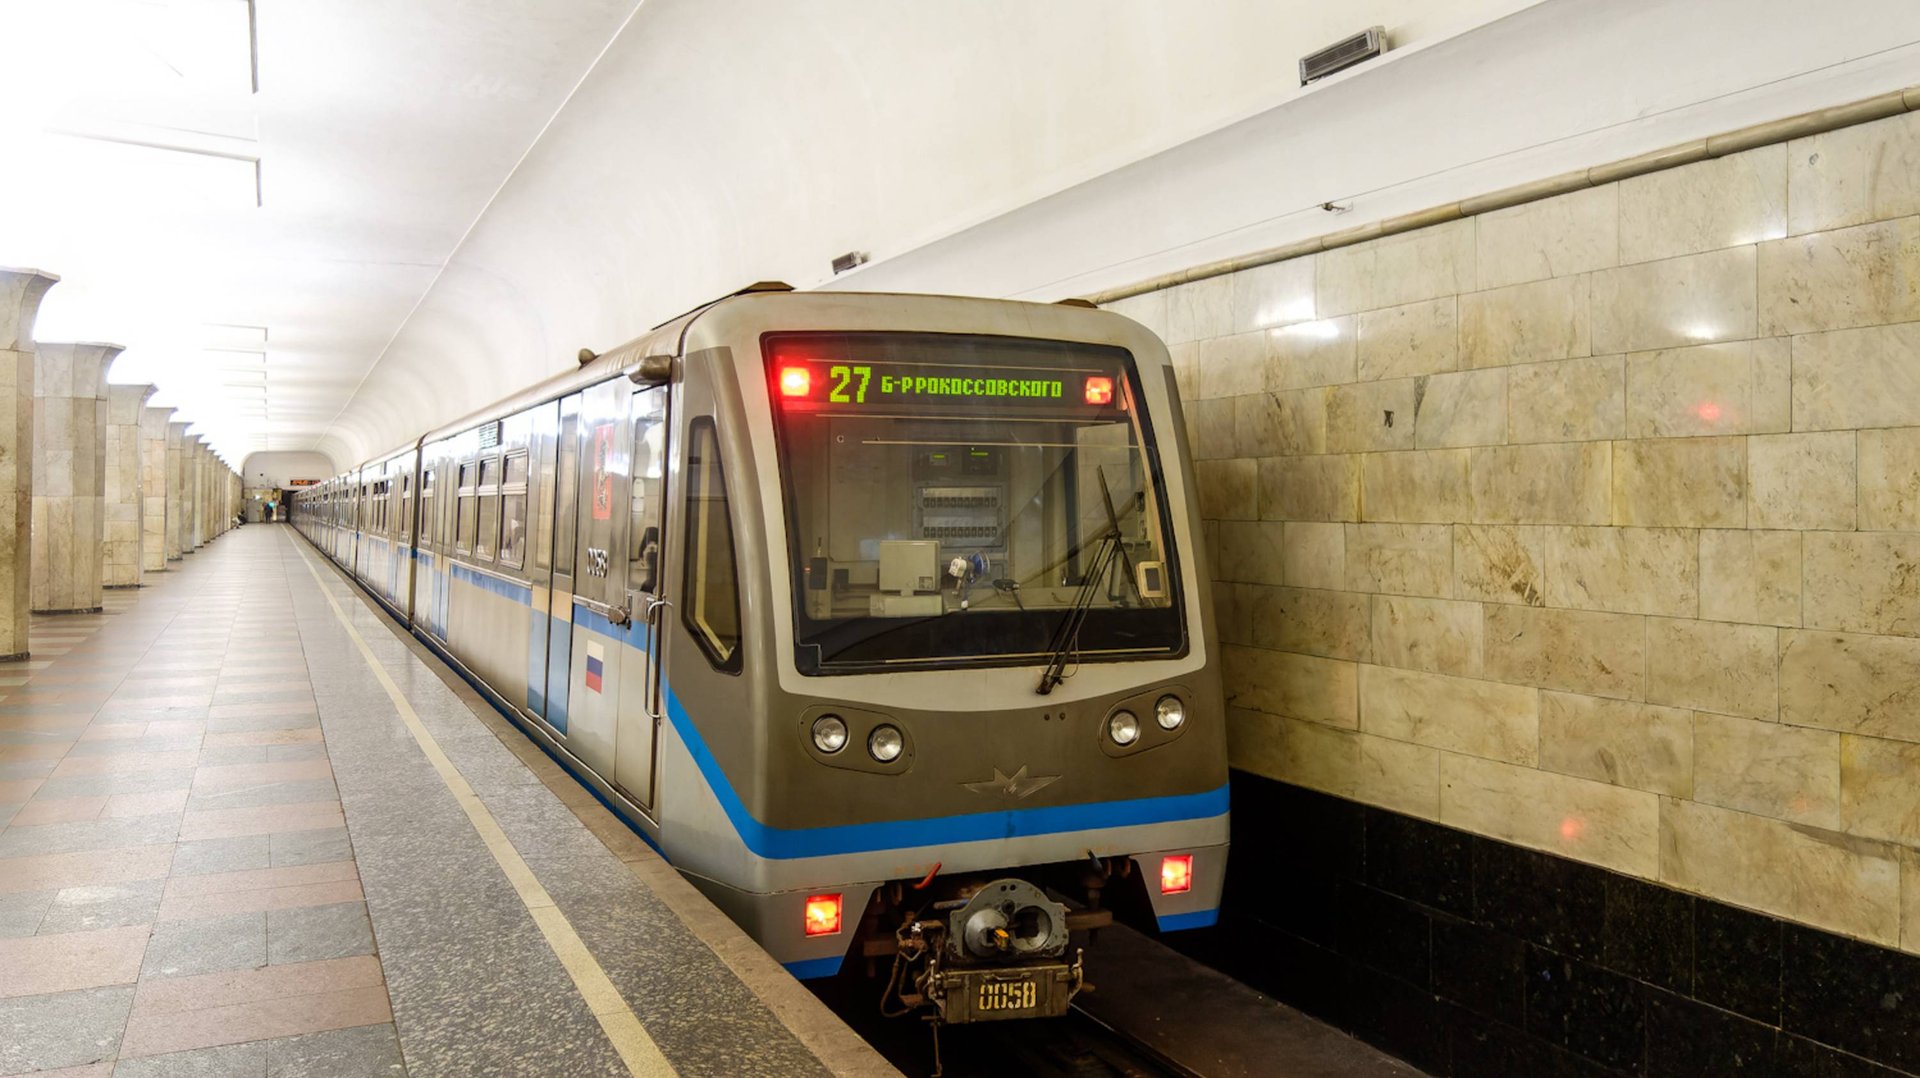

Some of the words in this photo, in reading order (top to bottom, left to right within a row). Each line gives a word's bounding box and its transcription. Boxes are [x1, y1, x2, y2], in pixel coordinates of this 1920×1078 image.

[829, 365, 872, 403] 27
[881, 375, 913, 394] Б-Р
[915, 376, 1062, 398] РОКОССОВСКОГО
[979, 981, 1037, 1010] 0058
